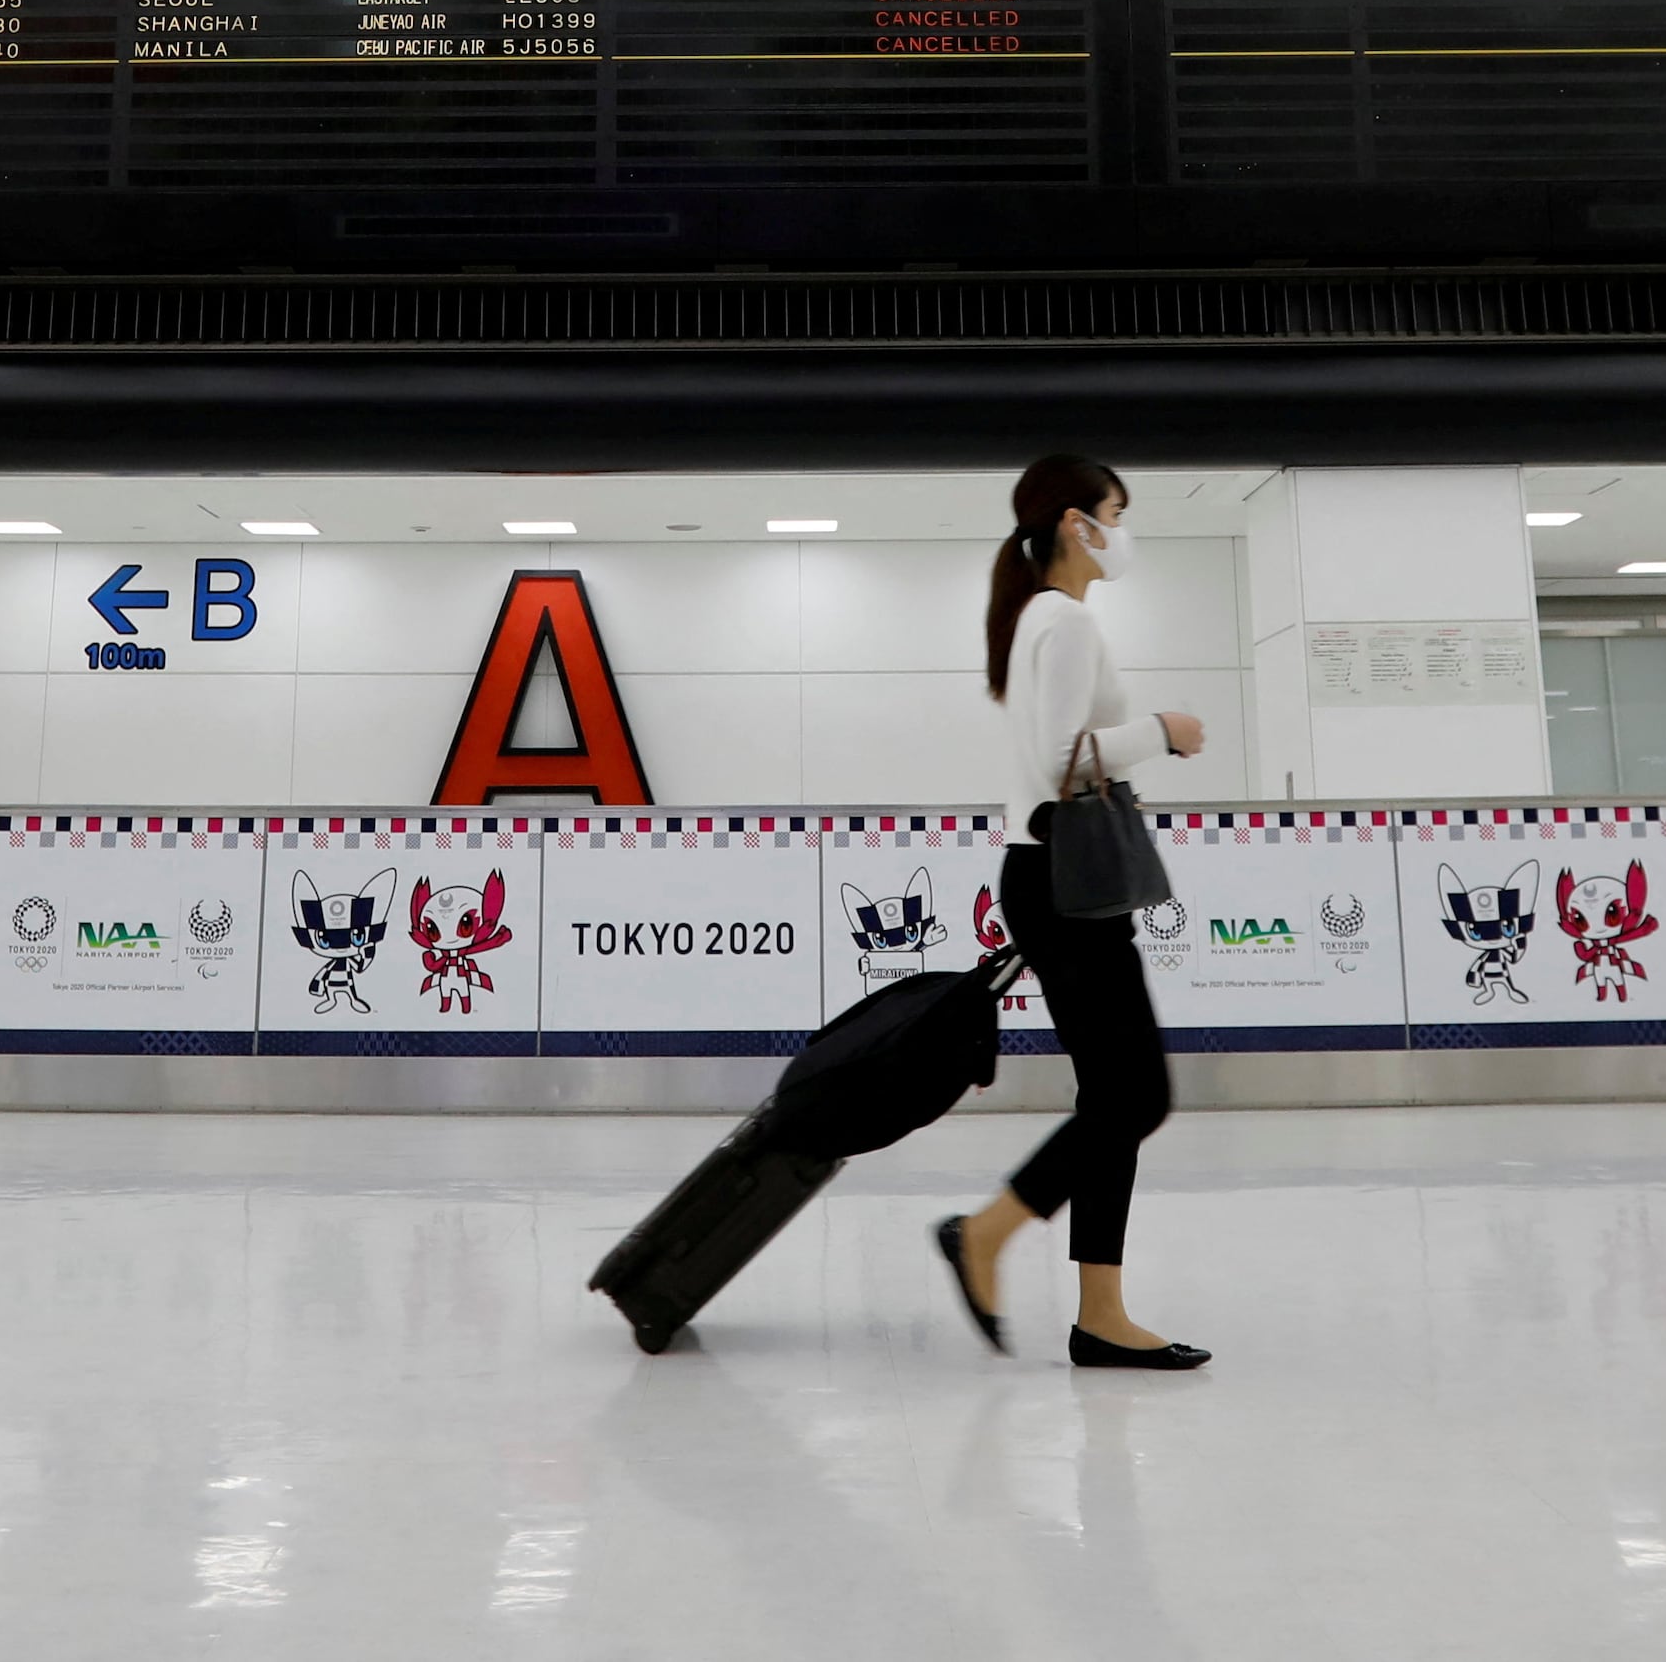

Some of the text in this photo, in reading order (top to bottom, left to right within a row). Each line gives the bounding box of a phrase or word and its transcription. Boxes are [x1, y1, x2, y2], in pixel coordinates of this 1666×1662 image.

[191, 557, 258, 642] B
[84, 642, 167, 670] 100m
[430, 569, 655, 807] A
[77, 922, 161, 948] NAA
[572, 922, 793, 955] TOKYO 2020
[1210, 918, 1296, 945] NAA
[37, 946, 56, 954] 2020
[185, 947, 233, 955] TOKYO 2020
[1142, 944, 1191, 952] TOKYO 2020
[1350, 941, 1369, 949] 2020
